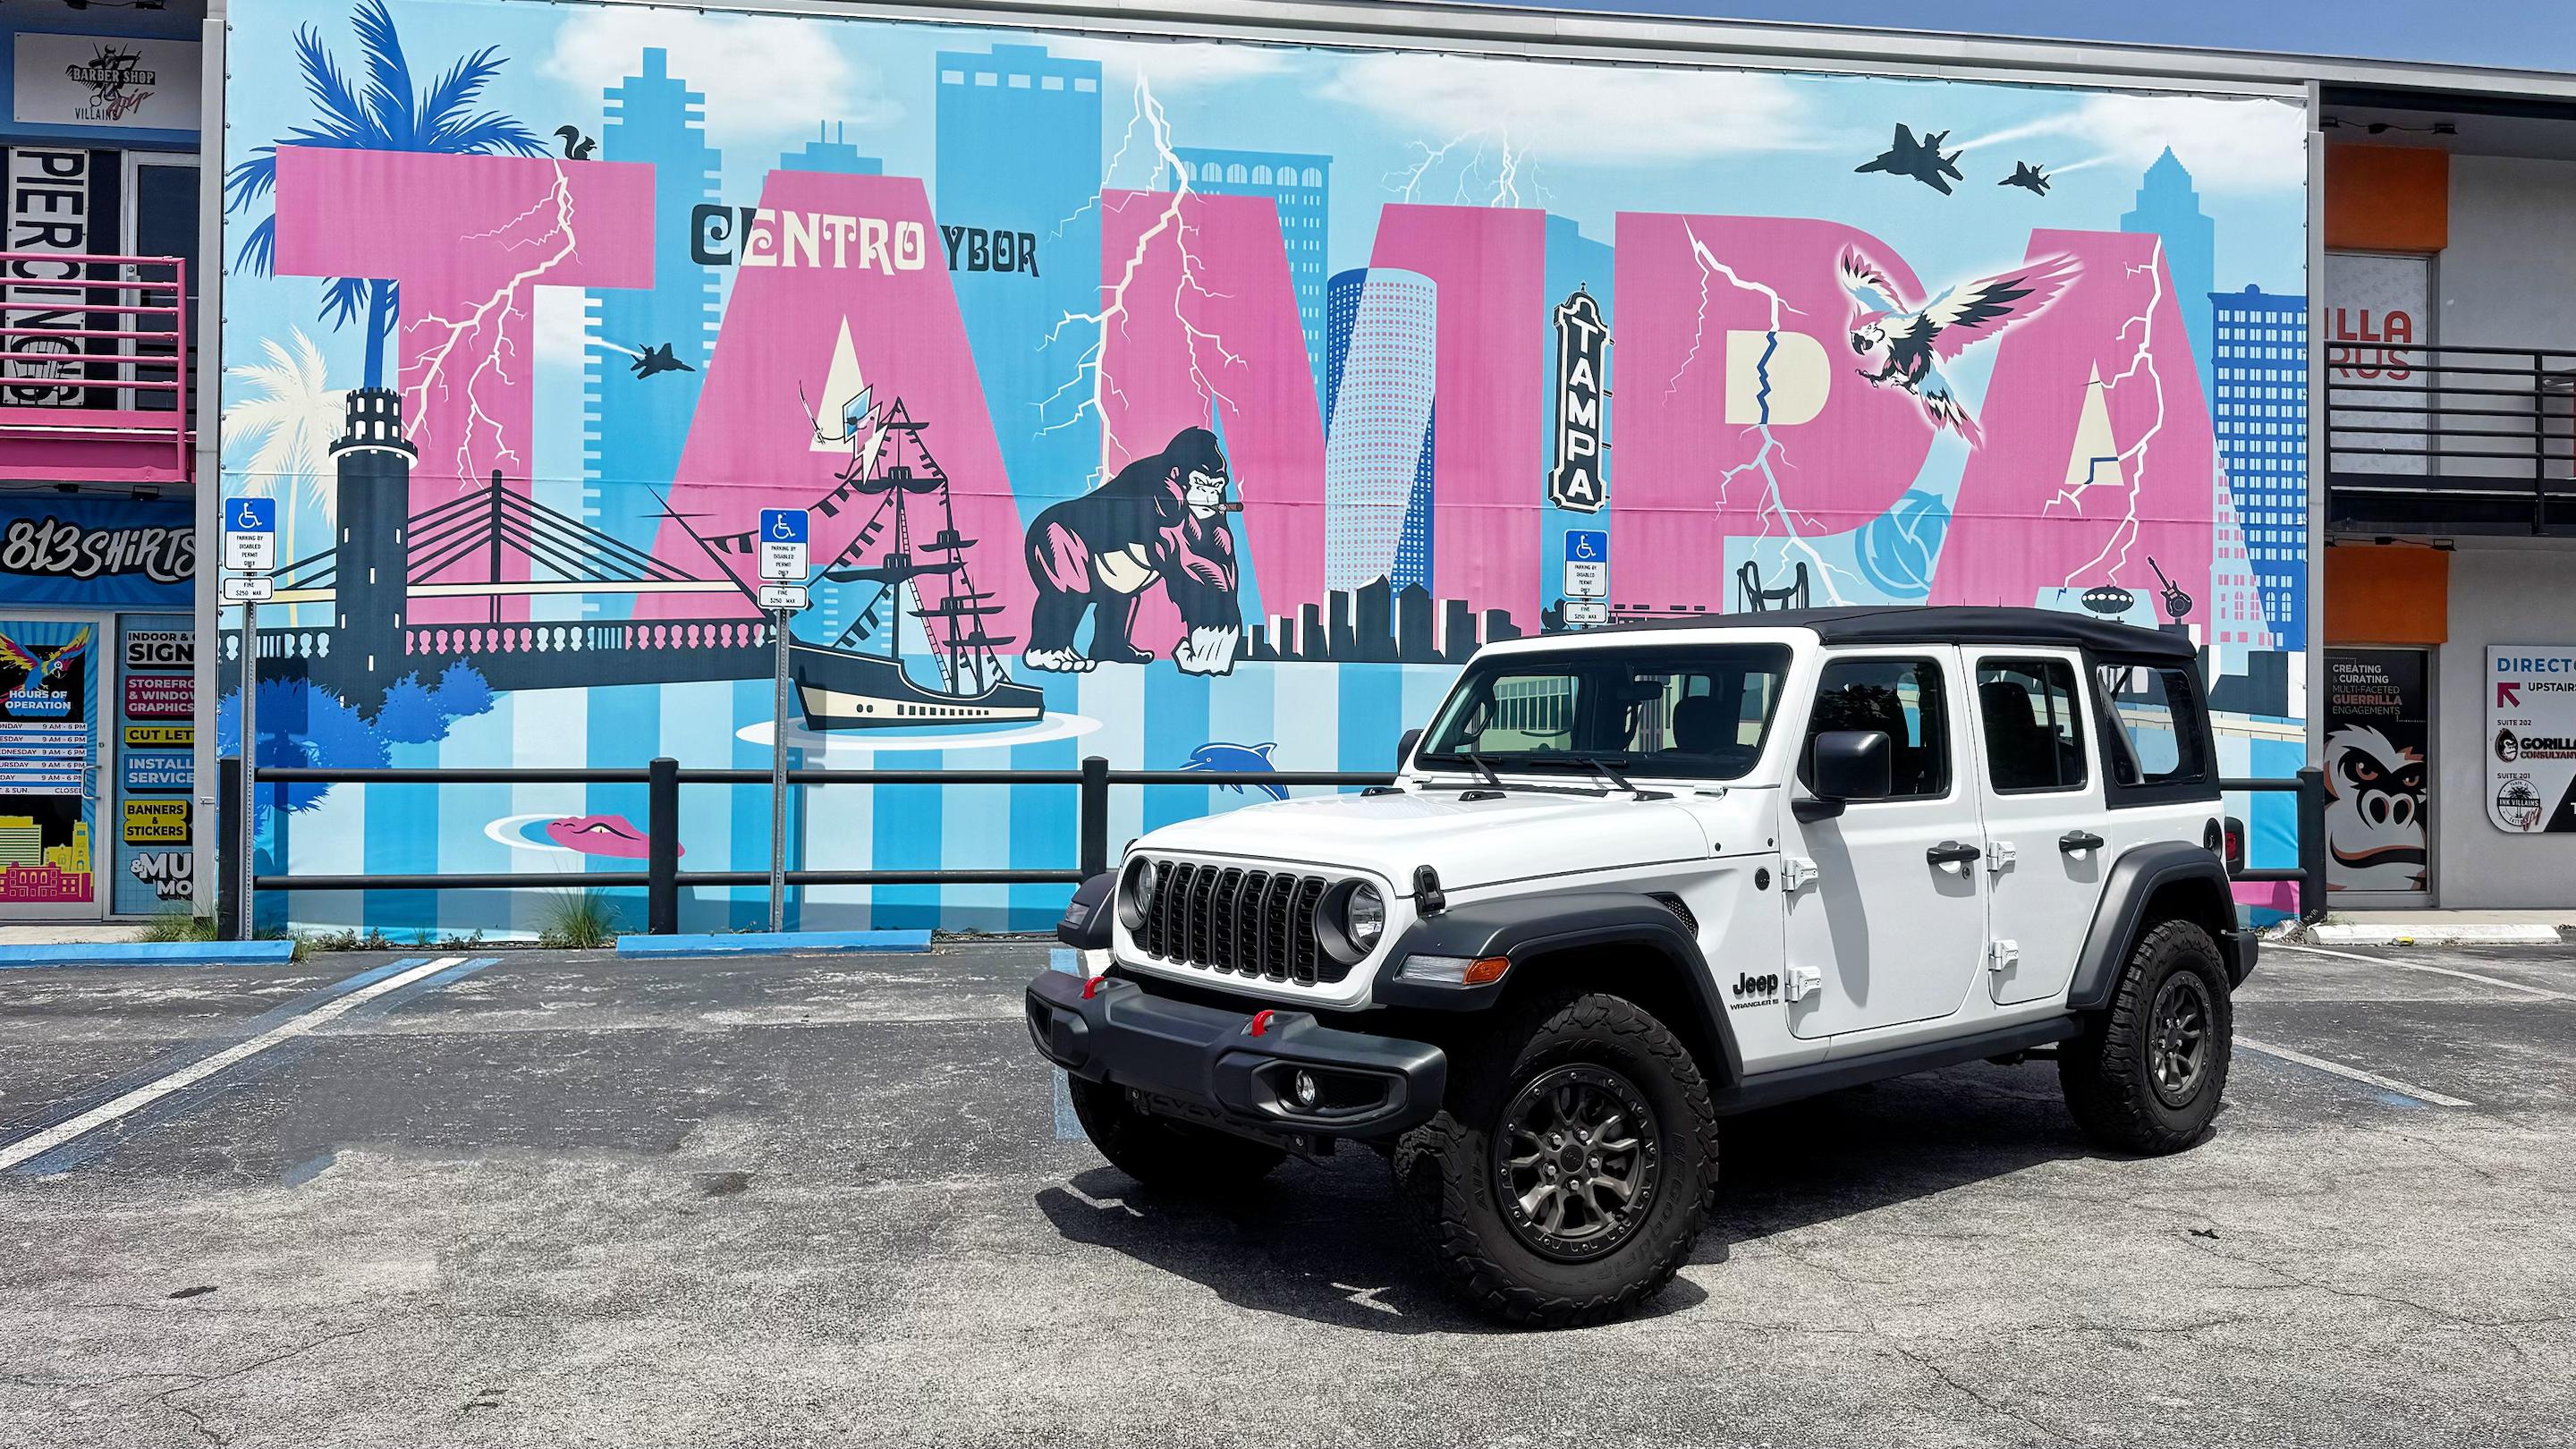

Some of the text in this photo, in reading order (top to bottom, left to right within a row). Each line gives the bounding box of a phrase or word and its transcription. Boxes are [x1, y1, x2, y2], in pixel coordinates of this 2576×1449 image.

[72, 68, 155, 84] BARBER SHOP
[691, 204, 1039, 277] CENTRO YBOR
[1566, 316, 1598, 501] TAMPA
[2, 519, 80, 572] 813
[128, 632, 177, 641] INDOOR
[180, 633, 189, 641] &
[128, 643, 194, 662] SIGN
[2333, 664, 2382, 674] CREATING
[2497, 657, 2576, 673] DIRECT
[2339, 674, 2389, 684] CURATING
[2333, 684, 2400, 694] MULTI-FACETED
[2528, 682, 2576, 691] UPSTAIR
[9, 691, 67, 699] HOURS OF
[128, 691, 138, 700] &
[2333, 694, 2402, 706] GUERRILLA
[4, 701, 72, 709] OPERATION
[128, 702, 194, 712] GRAPHICS
[2333, 706, 2401, 716] ENGAGEMENTS
[129, 729, 160, 741] CUT
[2520, 738, 2576, 750] GORILL
[127, 804, 184, 815] BANNERS
[152, 817, 158, 825] &
[126, 826, 184, 836] STICKERS
[1733, 971, 1778, 996] Jeep
[1730, 1000, 1771, 1010] WRANGLER
